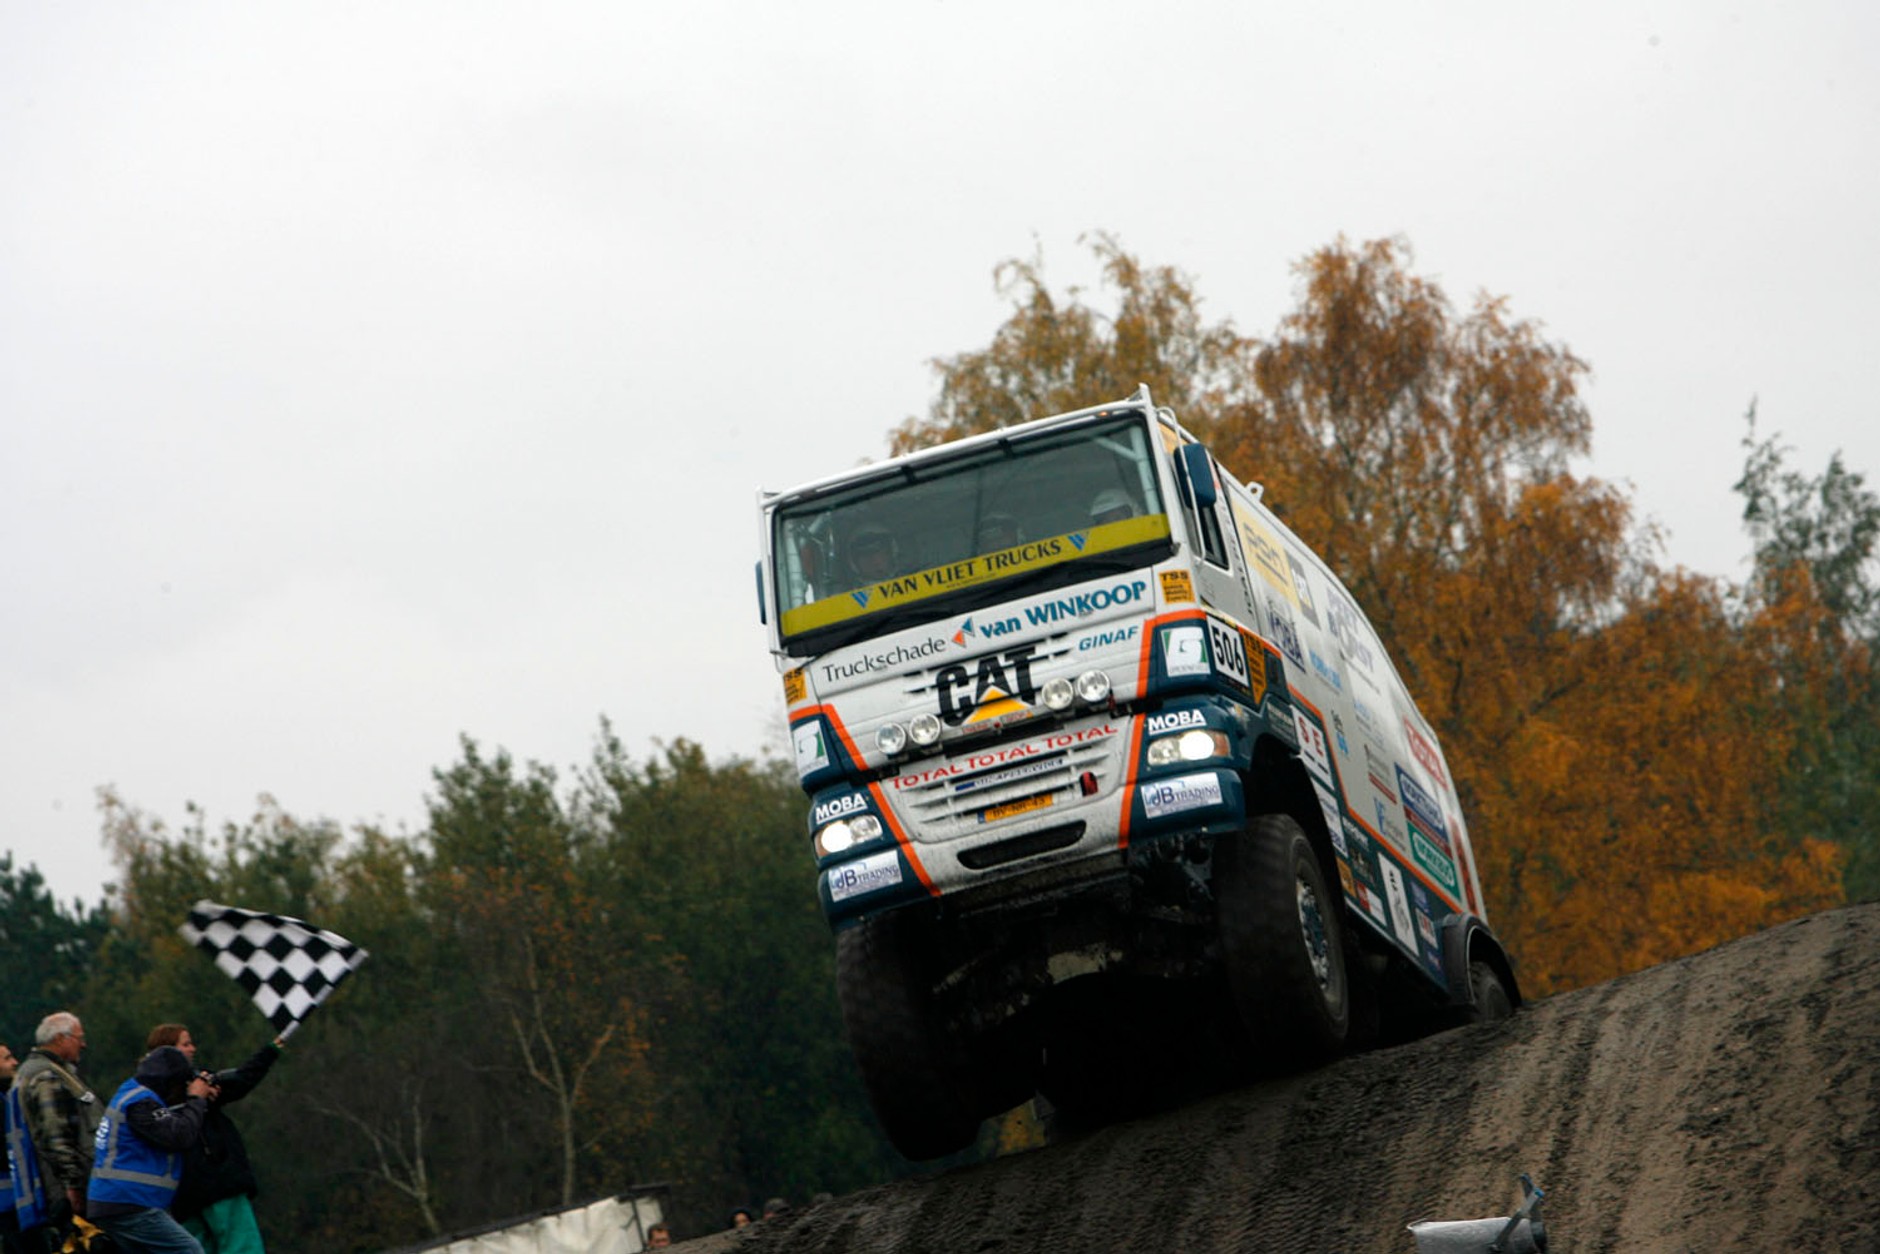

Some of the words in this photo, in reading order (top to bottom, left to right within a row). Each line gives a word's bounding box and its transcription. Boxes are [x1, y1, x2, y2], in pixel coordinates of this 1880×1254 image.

[878, 576, 918, 598] VAN
[923, 560, 976, 586] VLIET
[982, 539, 1063, 572] TRUCKS
[822, 637, 946, 683] Truckschade
[979, 617, 1022, 639] van
[1024, 580, 1147, 626] WINKOOP
[1079, 625, 1139, 651] GINAF
[1211, 624, 1244, 677] 506
[936, 645, 1036, 727] CAT
[1147, 708, 1206, 732] MOBA
[887, 763, 964, 791] TOTAL
[965, 743, 1041, 771] TOTAL
[1042, 723, 1119, 751] TOTAL
[815, 792, 866, 820] MOBA
